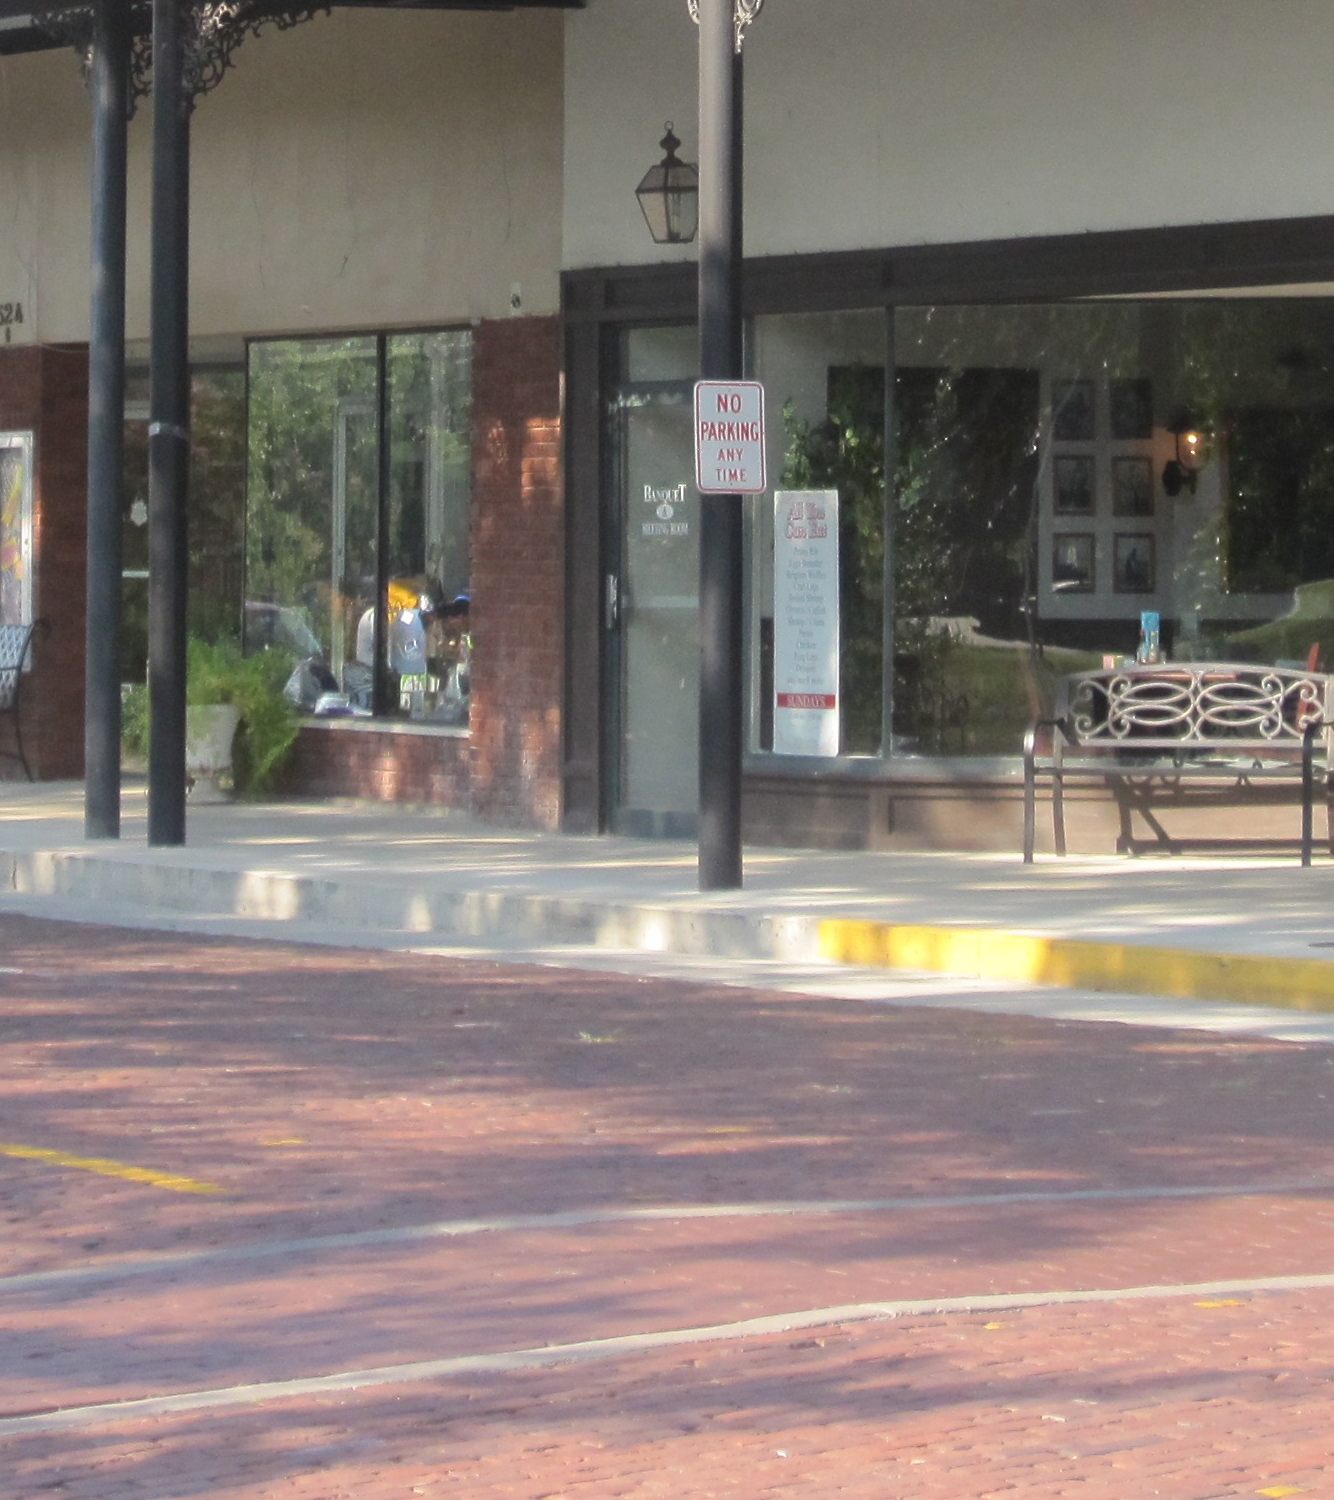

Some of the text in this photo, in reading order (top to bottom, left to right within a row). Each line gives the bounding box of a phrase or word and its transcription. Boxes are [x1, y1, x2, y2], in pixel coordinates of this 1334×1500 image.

[717, 393, 742, 413] NO
[700, 422, 759, 442] PARKING
[718, 449, 743, 461] ANY
[716, 468, 746, 482] TIME
[643, 484, 687, 503] BANQUET
[787, 694, 826, 707] SUNDAYS
